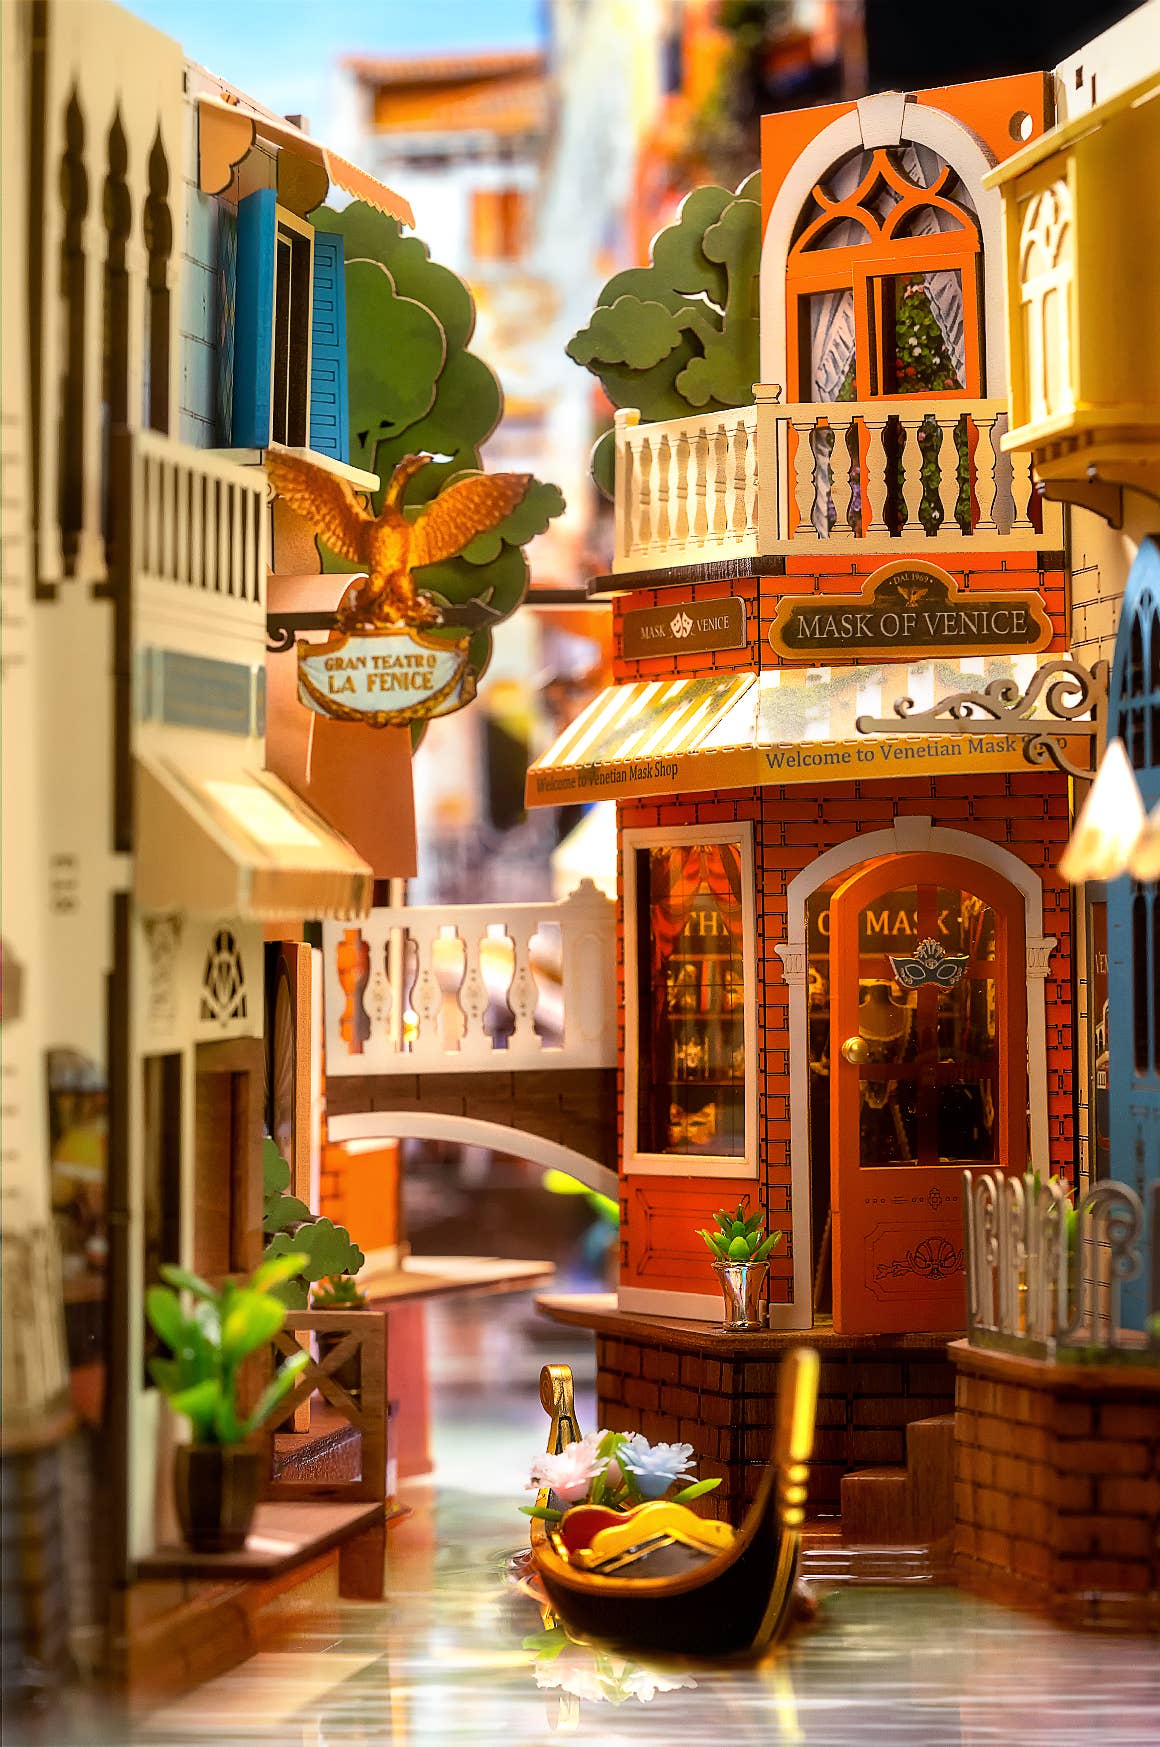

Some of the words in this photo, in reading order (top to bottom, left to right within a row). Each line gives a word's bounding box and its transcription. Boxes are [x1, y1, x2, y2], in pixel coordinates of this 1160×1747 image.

[640, 624, 666, 640] MASK
[696, 615, 730, 632] VENICE
[797, 611, 874, 639] MASK
[880, 612, 916, 637] OF
[922, 609, 1028, 636] VENICE
[325, 657, 367, 671] GRAN
[372, 655, 437, 669] TEATRO
[328, 676, 356, 694] LA
[366, 671, 434, 692] FENICE
[766, 750, 851, 769] Welcome
[856, 747, 875, 762] to
[879, 741, 962, 761] Venetian
[967, 736, 1017, 754] Mask
[536, 775, 577, 793] Welcome
[577, 774, 587, 788] to
[588, 767, 627, 787] Venetian
[629, 763, 653, 781] Mask
[654, 761, 678, 780] Shop
